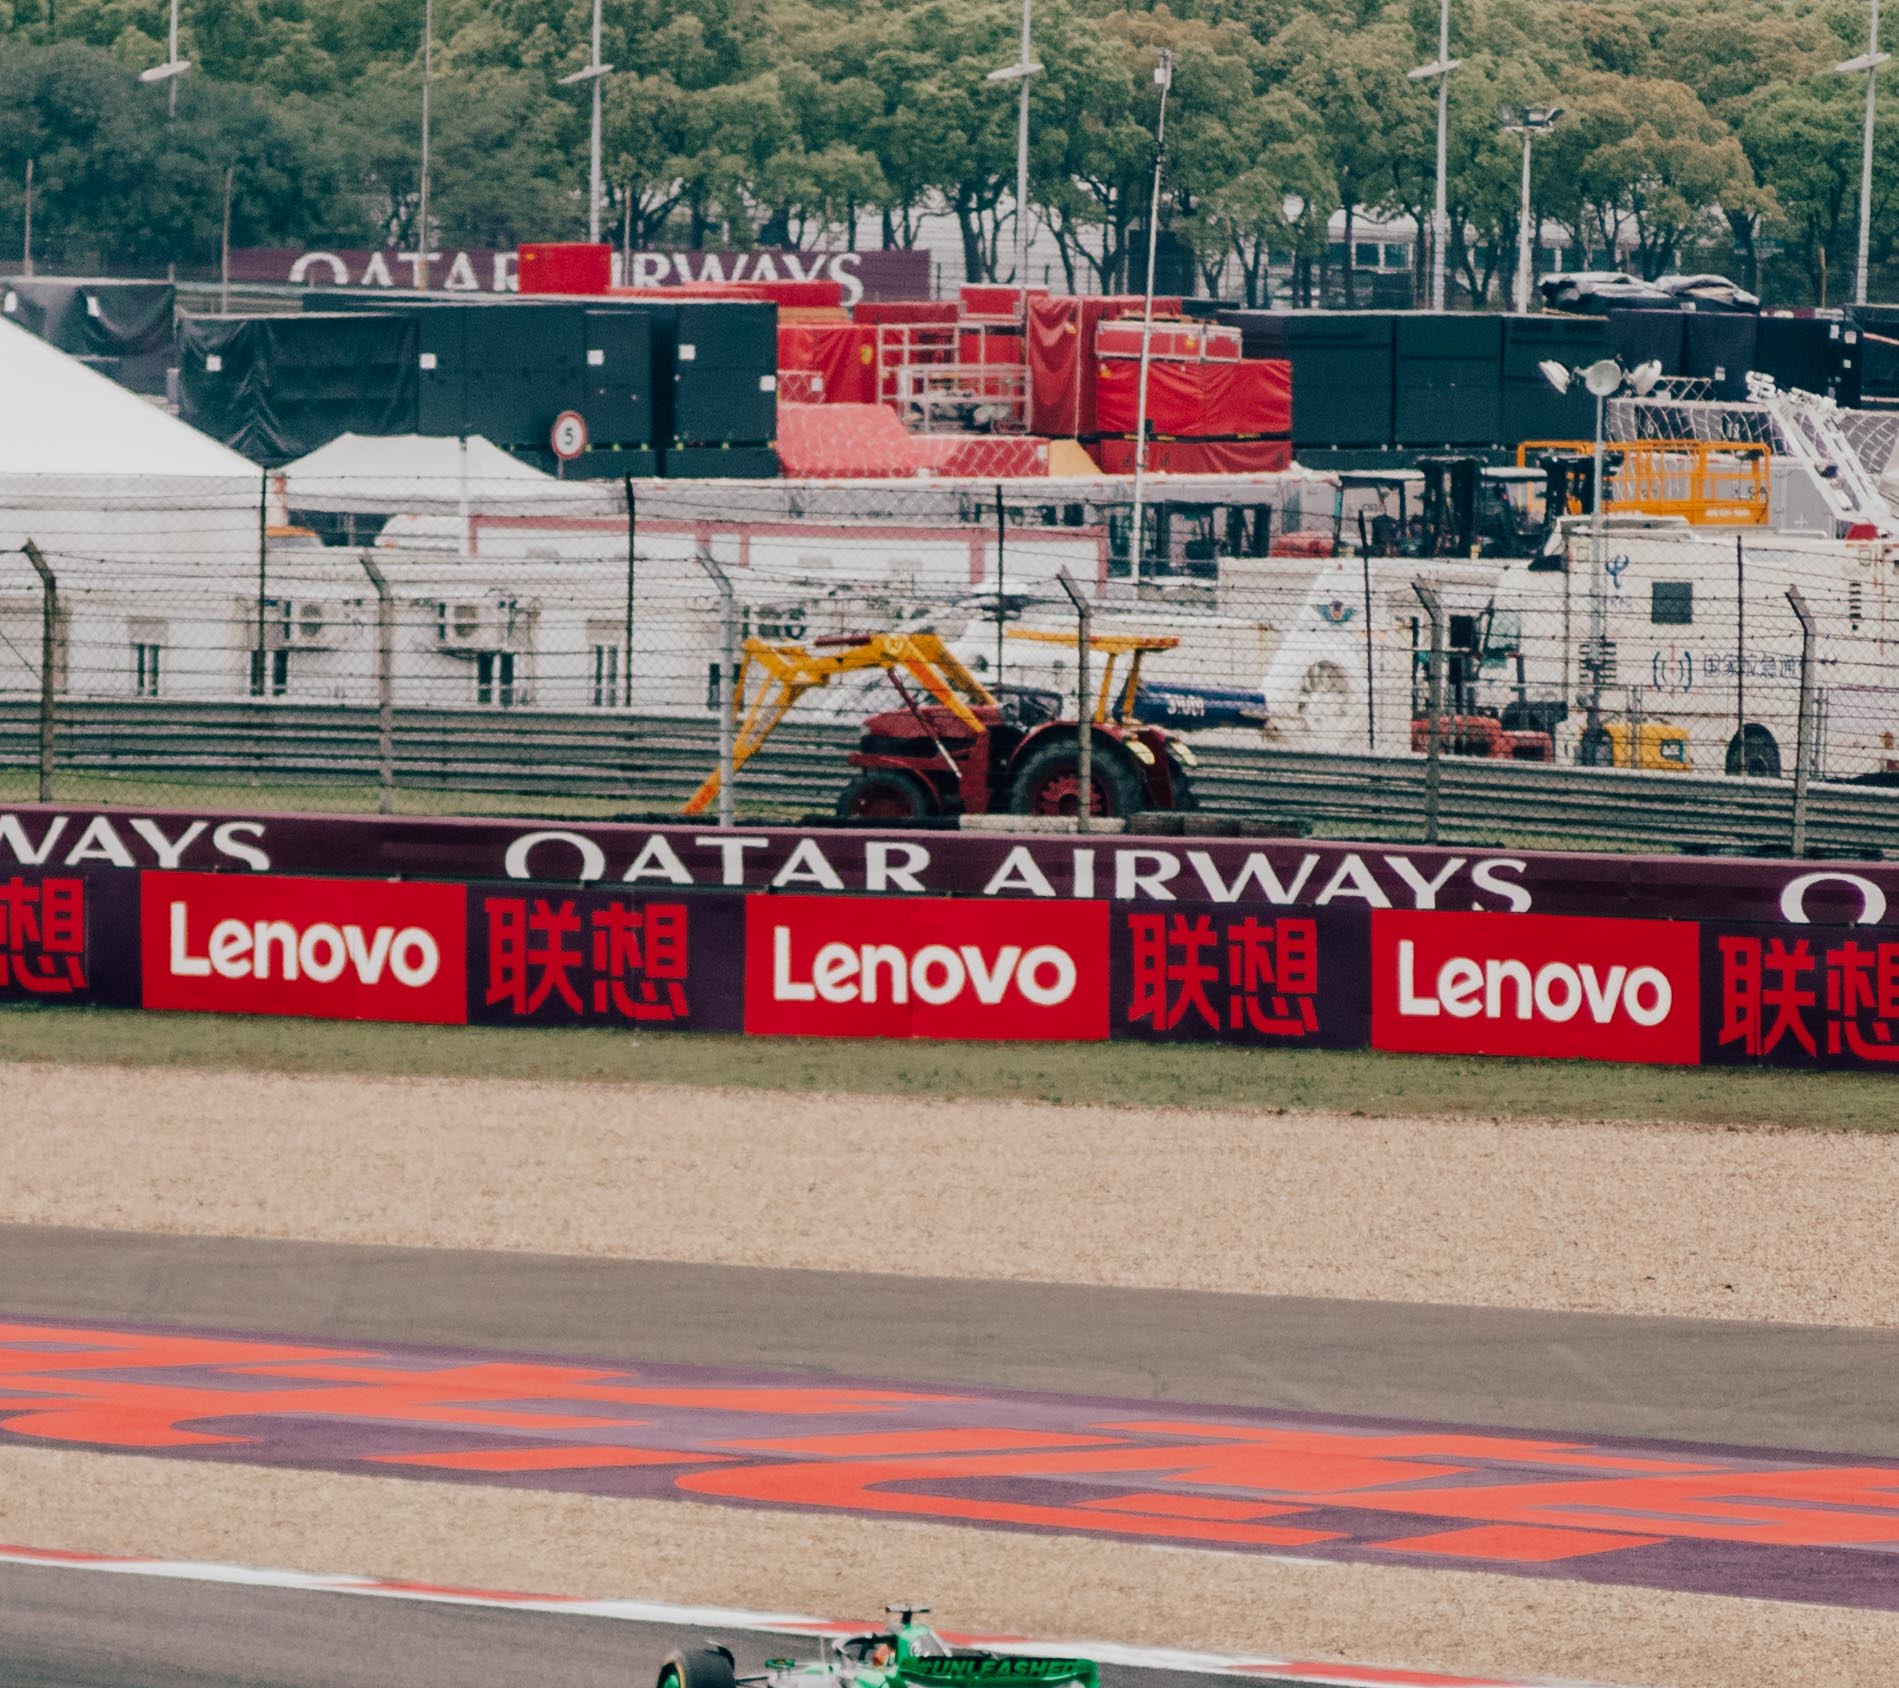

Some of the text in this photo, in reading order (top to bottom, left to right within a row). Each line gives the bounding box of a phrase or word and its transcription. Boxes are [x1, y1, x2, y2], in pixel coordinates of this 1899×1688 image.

[610, 252, 864, 307] IRWAYS
[564, 426, 574, 446] 5
[504, 831, 1534, 914] QATAR AIRWAYS
[169, 900, 440, 988] Lenovo
[485, 897, 689, 1021] 联想
[773, 925, 1077, 1006] Lenovo
[1127, 912, 1320, 1036] 联想
[1398, 938, 1673, 1027] Lenovo
[1717, 934, 1899, 1061] 联想
